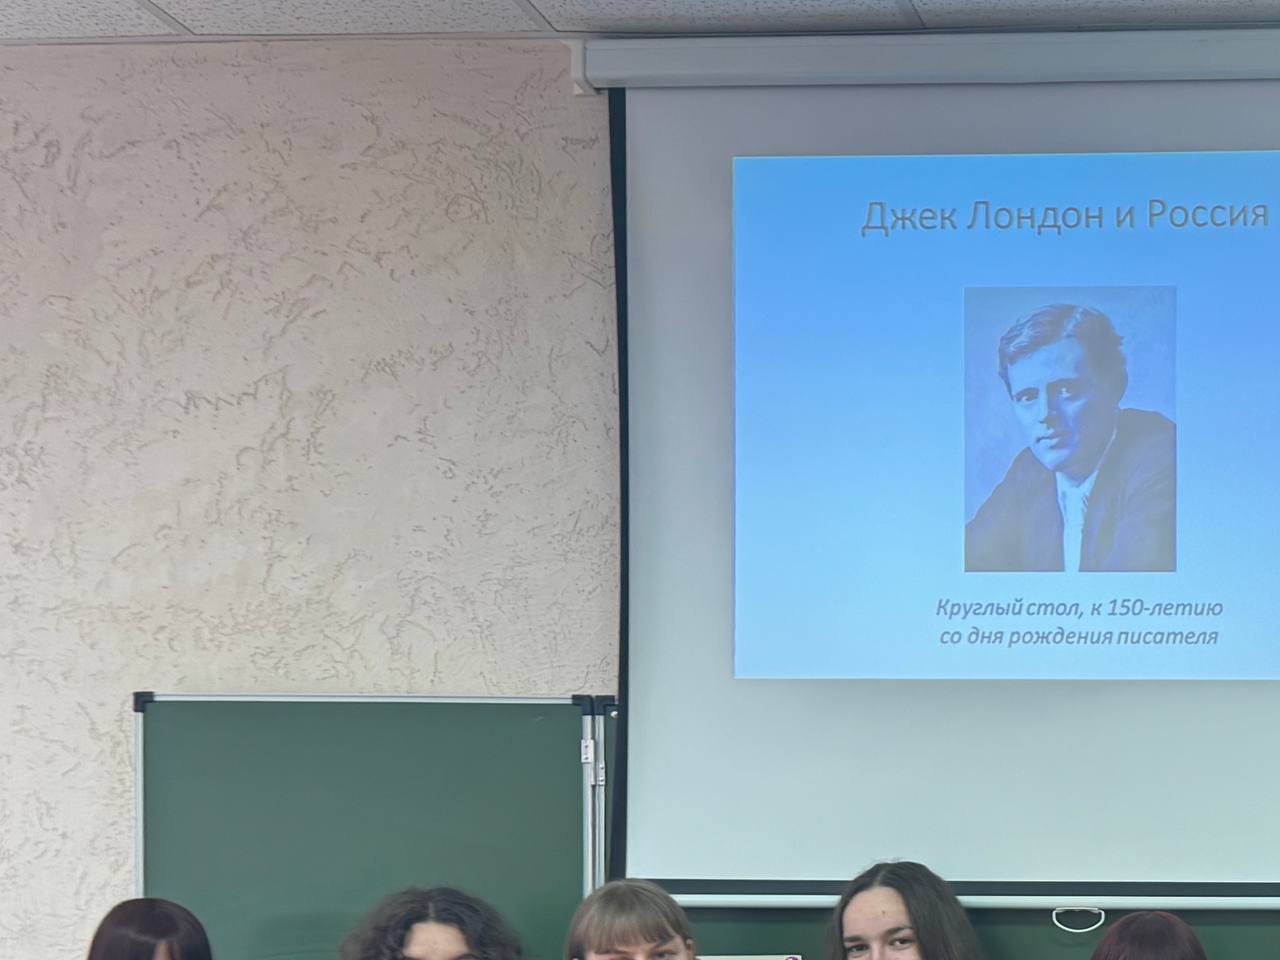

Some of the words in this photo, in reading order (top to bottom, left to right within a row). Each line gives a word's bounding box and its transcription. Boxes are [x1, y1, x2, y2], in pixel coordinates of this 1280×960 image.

[861, 200, 957, 237] Джек
[966, 200, 1104, 236] Лондон
[1116, 207, 1136, 228] и
[1148, 198, 1269, 228] Россия
[935, 598, 1024, 620] Круглый
[1027, 600, 1085, 619] стол,
[1091, 601, 1102, 616] к
[1107, 598, 1224, 617] 150-летию
[939, 630, 962, 645] со
[967, 626, 1004, 645] дня
[1008, 627, 1113, 648] рождения
[1116, 630, 1219, 645] писателя
